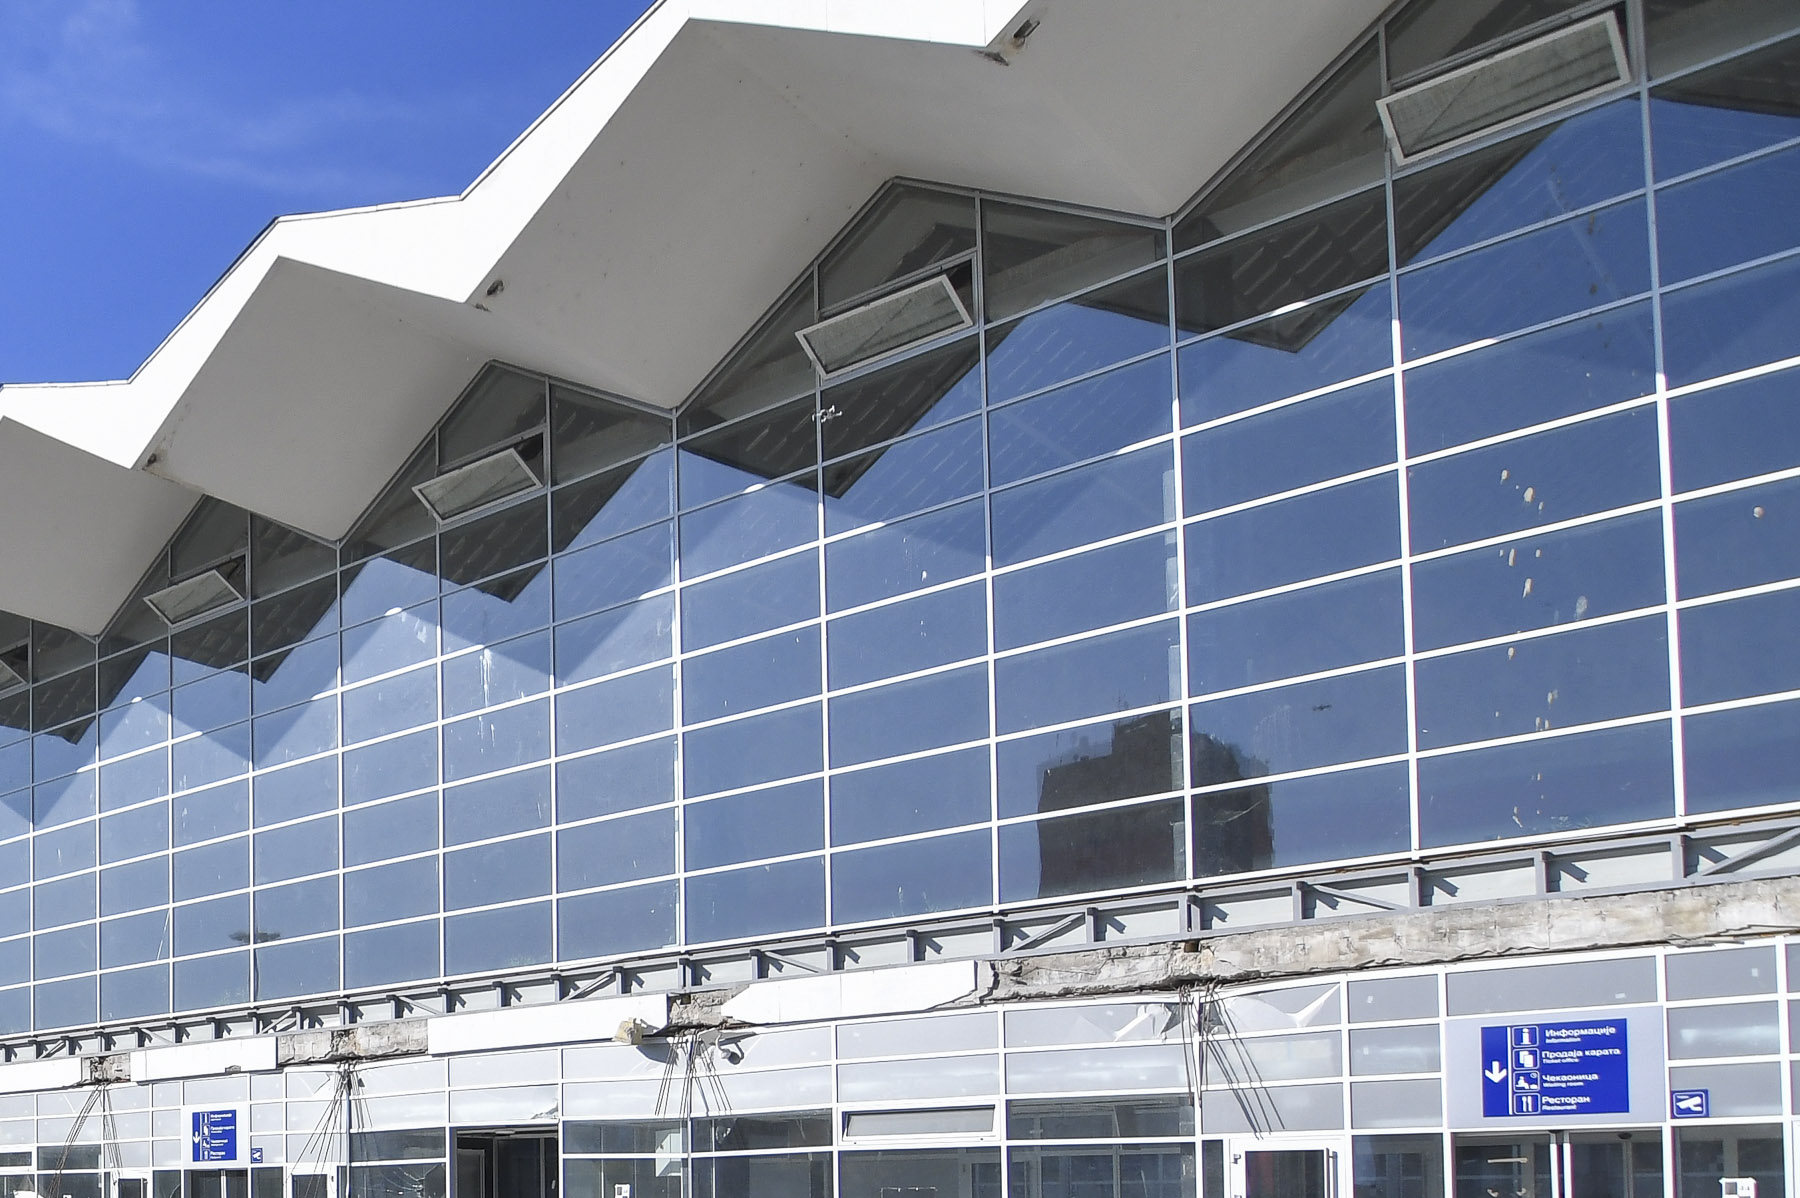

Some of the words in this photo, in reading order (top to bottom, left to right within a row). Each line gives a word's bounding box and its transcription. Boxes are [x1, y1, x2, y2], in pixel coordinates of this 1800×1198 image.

[1545, 1026, 1616, 1037] Информације
[1541, 1050, 1584, 1060] Продаја
[1585, 1048, 1621, 1057] карата
[1541, 1096, 1591, 1105] Ресторан
